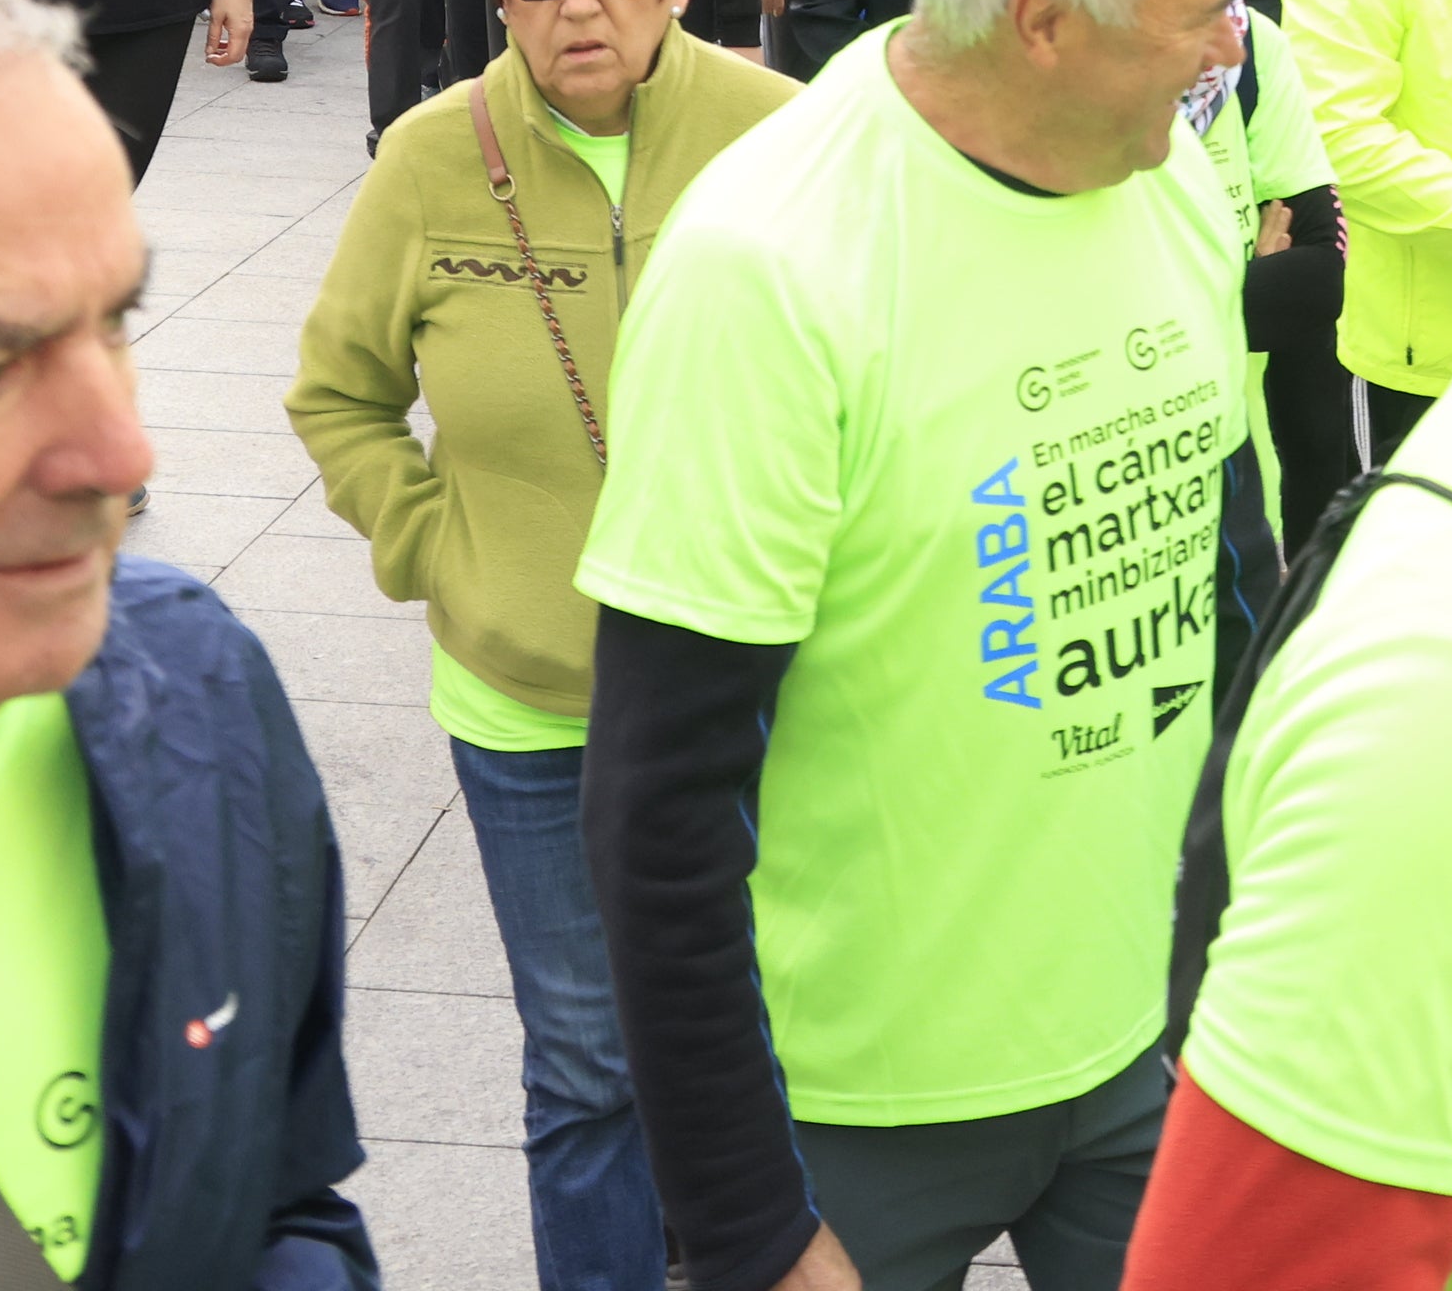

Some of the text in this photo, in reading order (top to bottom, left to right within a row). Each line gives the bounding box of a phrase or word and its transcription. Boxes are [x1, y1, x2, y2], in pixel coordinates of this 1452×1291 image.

[1032, 379, 1219, 468] En marcha contra
[1042, 414, 1222, 516] el cáncer
[970, 456, 1043, 710] ARABA
[1056, 571, 1217, 697] aurka
[1051, 712, 1122, 760] Vital
